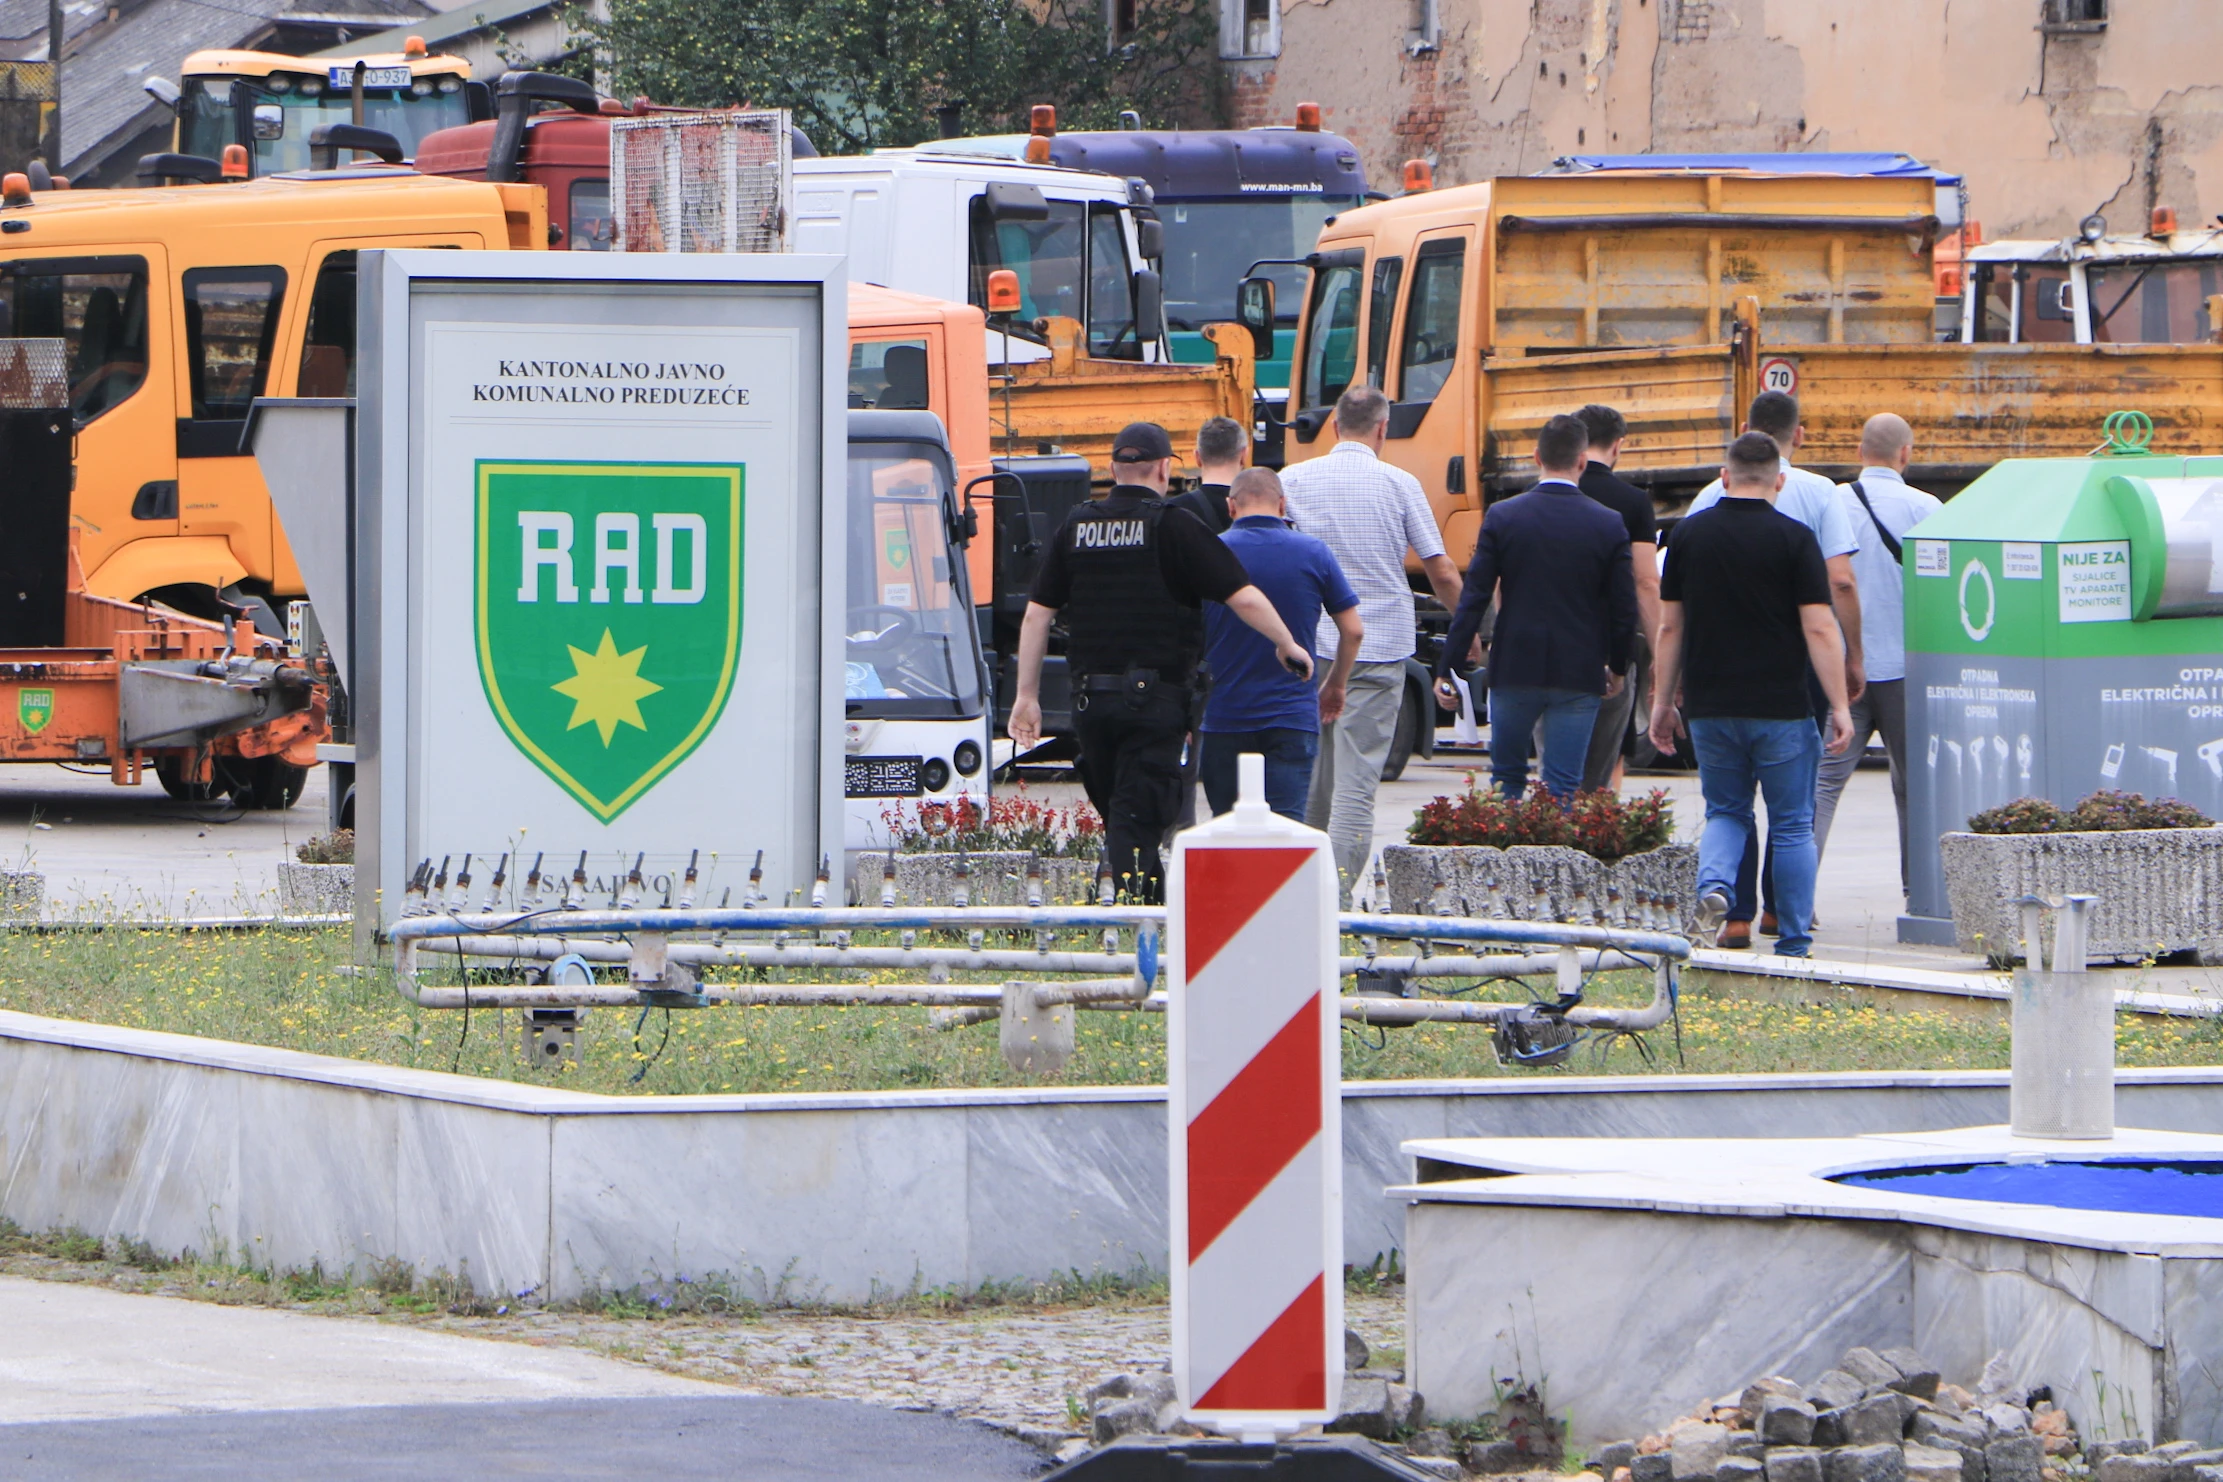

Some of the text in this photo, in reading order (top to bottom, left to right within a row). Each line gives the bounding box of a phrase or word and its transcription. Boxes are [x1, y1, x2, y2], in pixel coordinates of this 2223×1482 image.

[340, 70, 408, 84] A3-O-937
[1241, 182, 1323, 192] www.man-mn.ba
[498, 360, 725, 380] KANTONALNO JAVNO
[1770, 371, 1789, 387] 70
[473, 384, 750, 405] KOMUNALNO PREDUZEĆE
[1076, 520, 1144, 548] POLICIJA
[517, 511, 707, 604] RAD
[2063, 551, 2126, 566] NIJE ZA
[2072, 571, 2117, 582] SIJALICE
[2064, 583, 2127, 595] TV APARATE
[2068, 596, 2122, 608] MONITORE
[23, 693, 50, 707] RAD
[2101, 684, 2208, 701] ELEKTRIČNA
